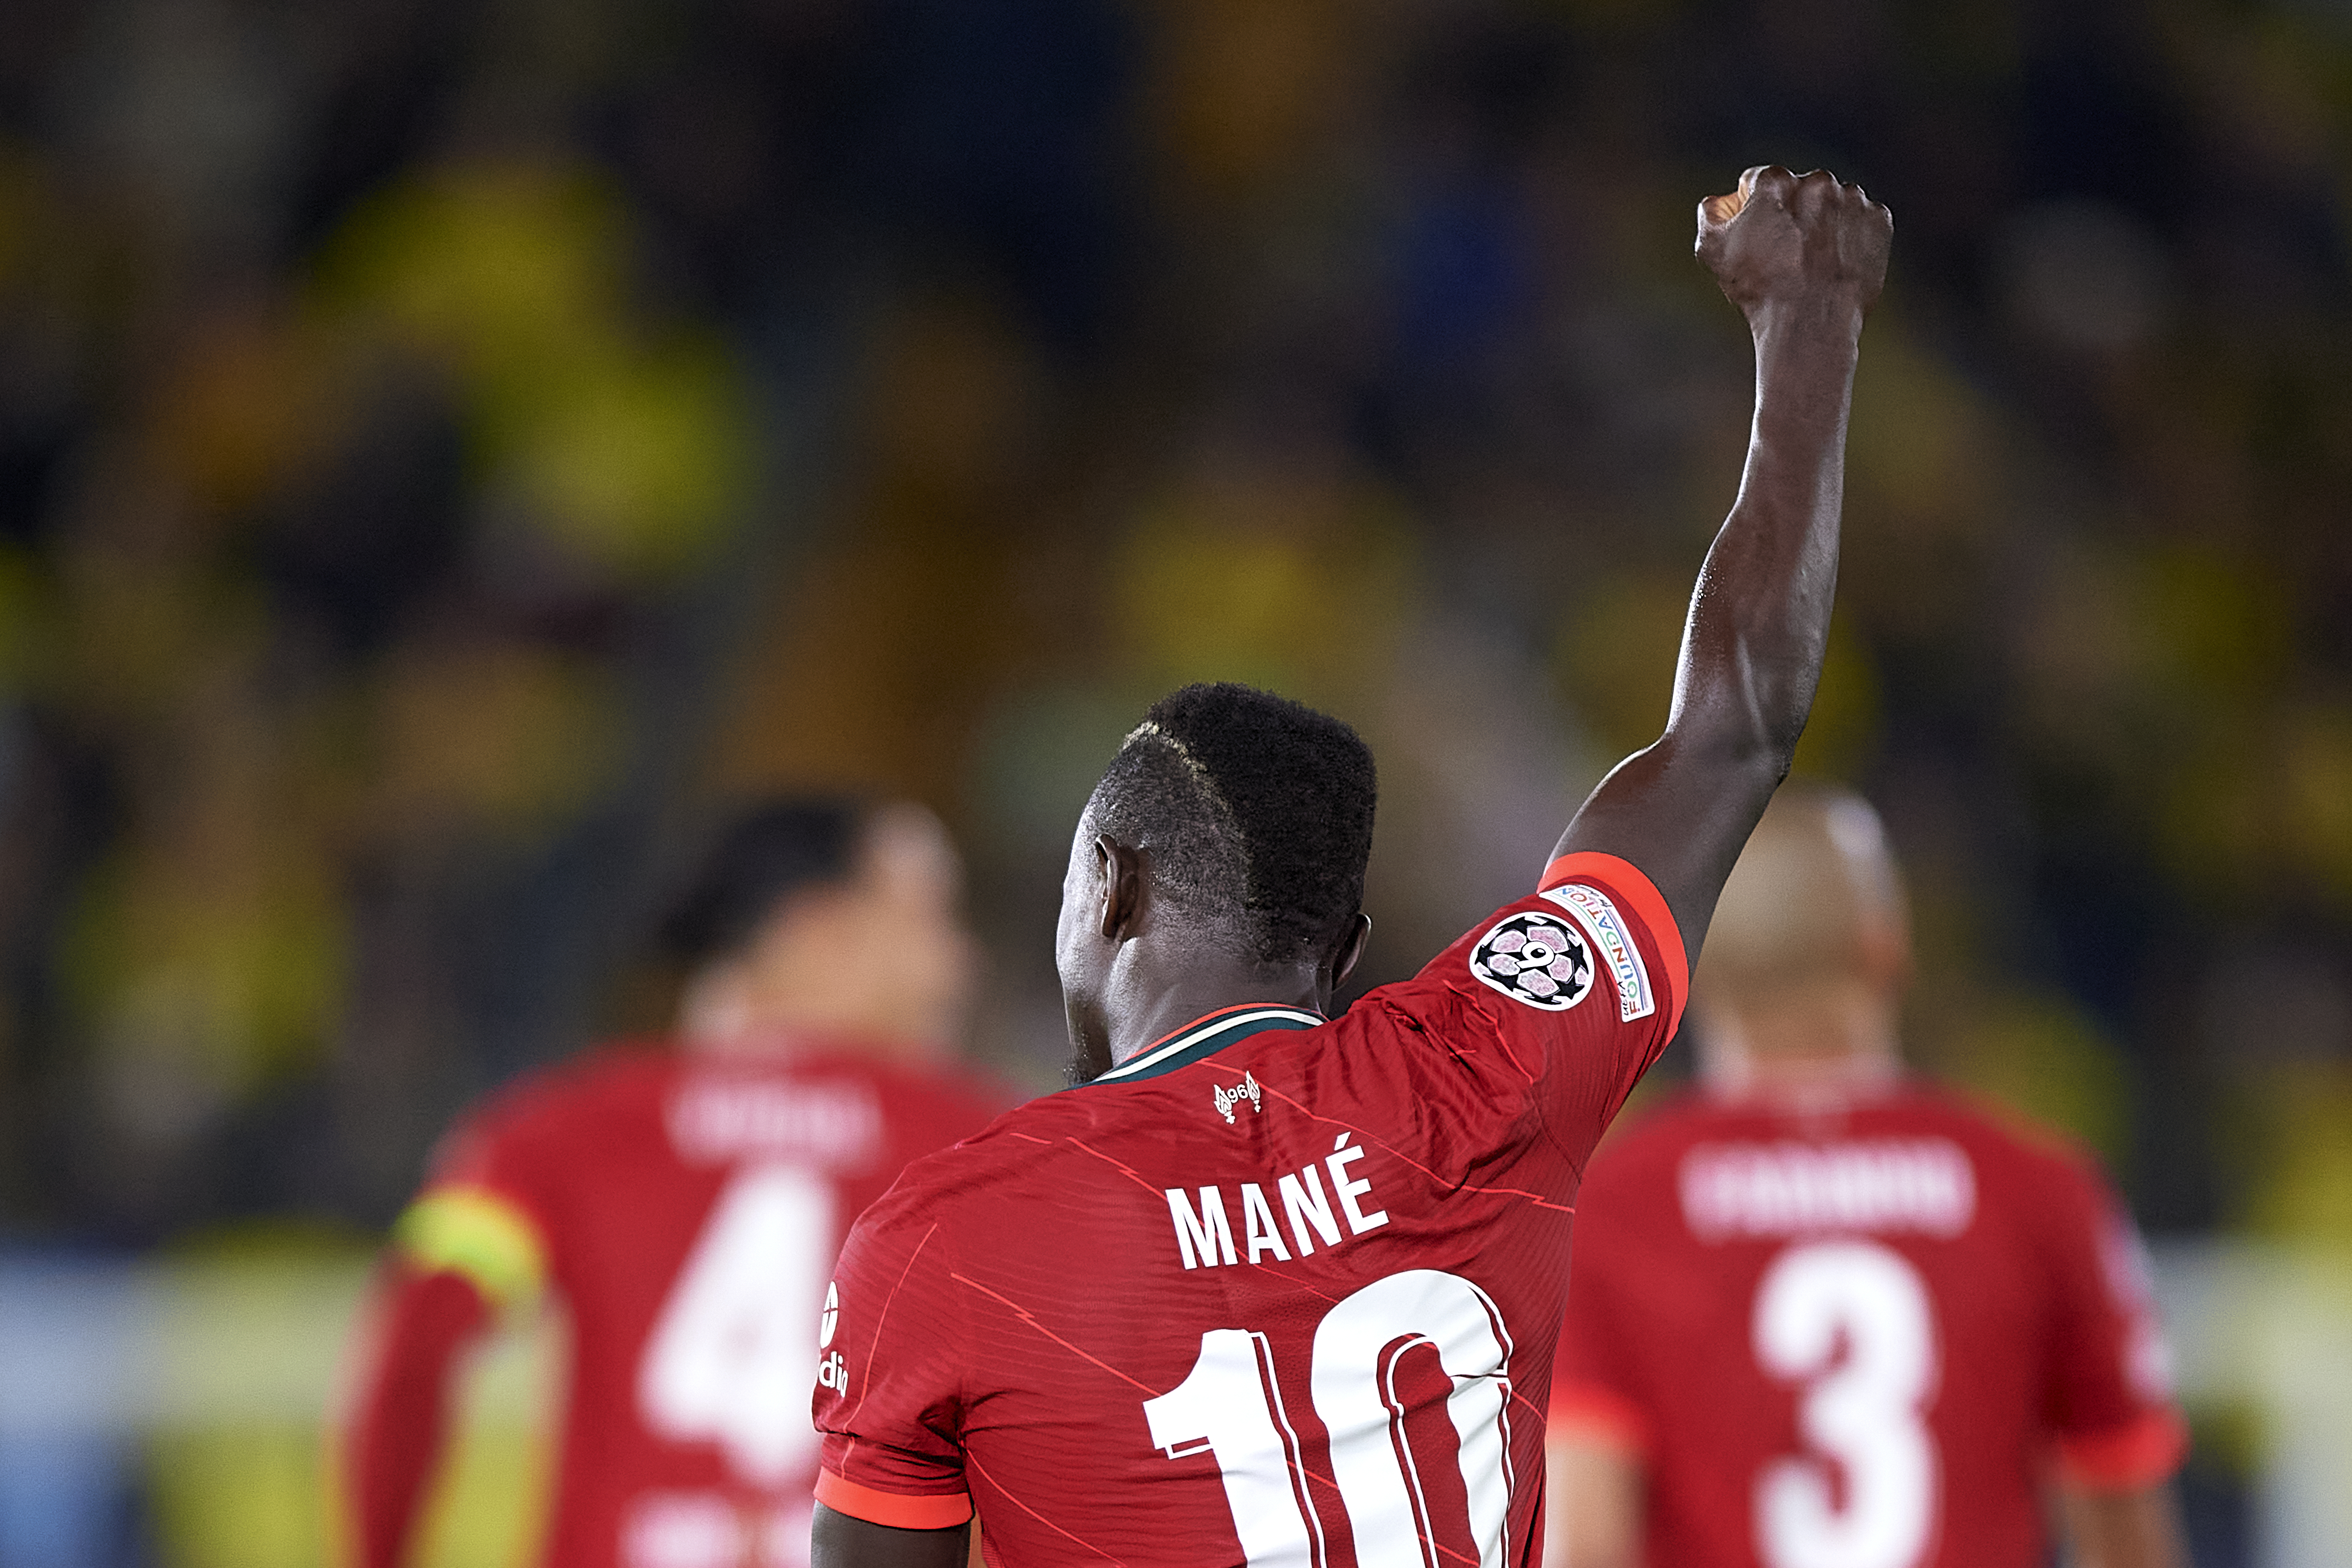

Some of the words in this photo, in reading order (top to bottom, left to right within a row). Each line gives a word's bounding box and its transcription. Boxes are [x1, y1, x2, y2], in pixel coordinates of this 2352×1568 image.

[1553, 887, 1641, 1015] FOUNDATION
[1617, 979, 1629, 1016] UEFA
[1227, 1084, 1249, 1104] 96
[1165, 1131, 1389, 1270] MANÉ
[638, 1167, 835, 1485] 4
[818, 1350, 848, 1398] dia
[1142, 1268, 1514, 1568] 10
[1751, 1242, 1942, 1568] 3
